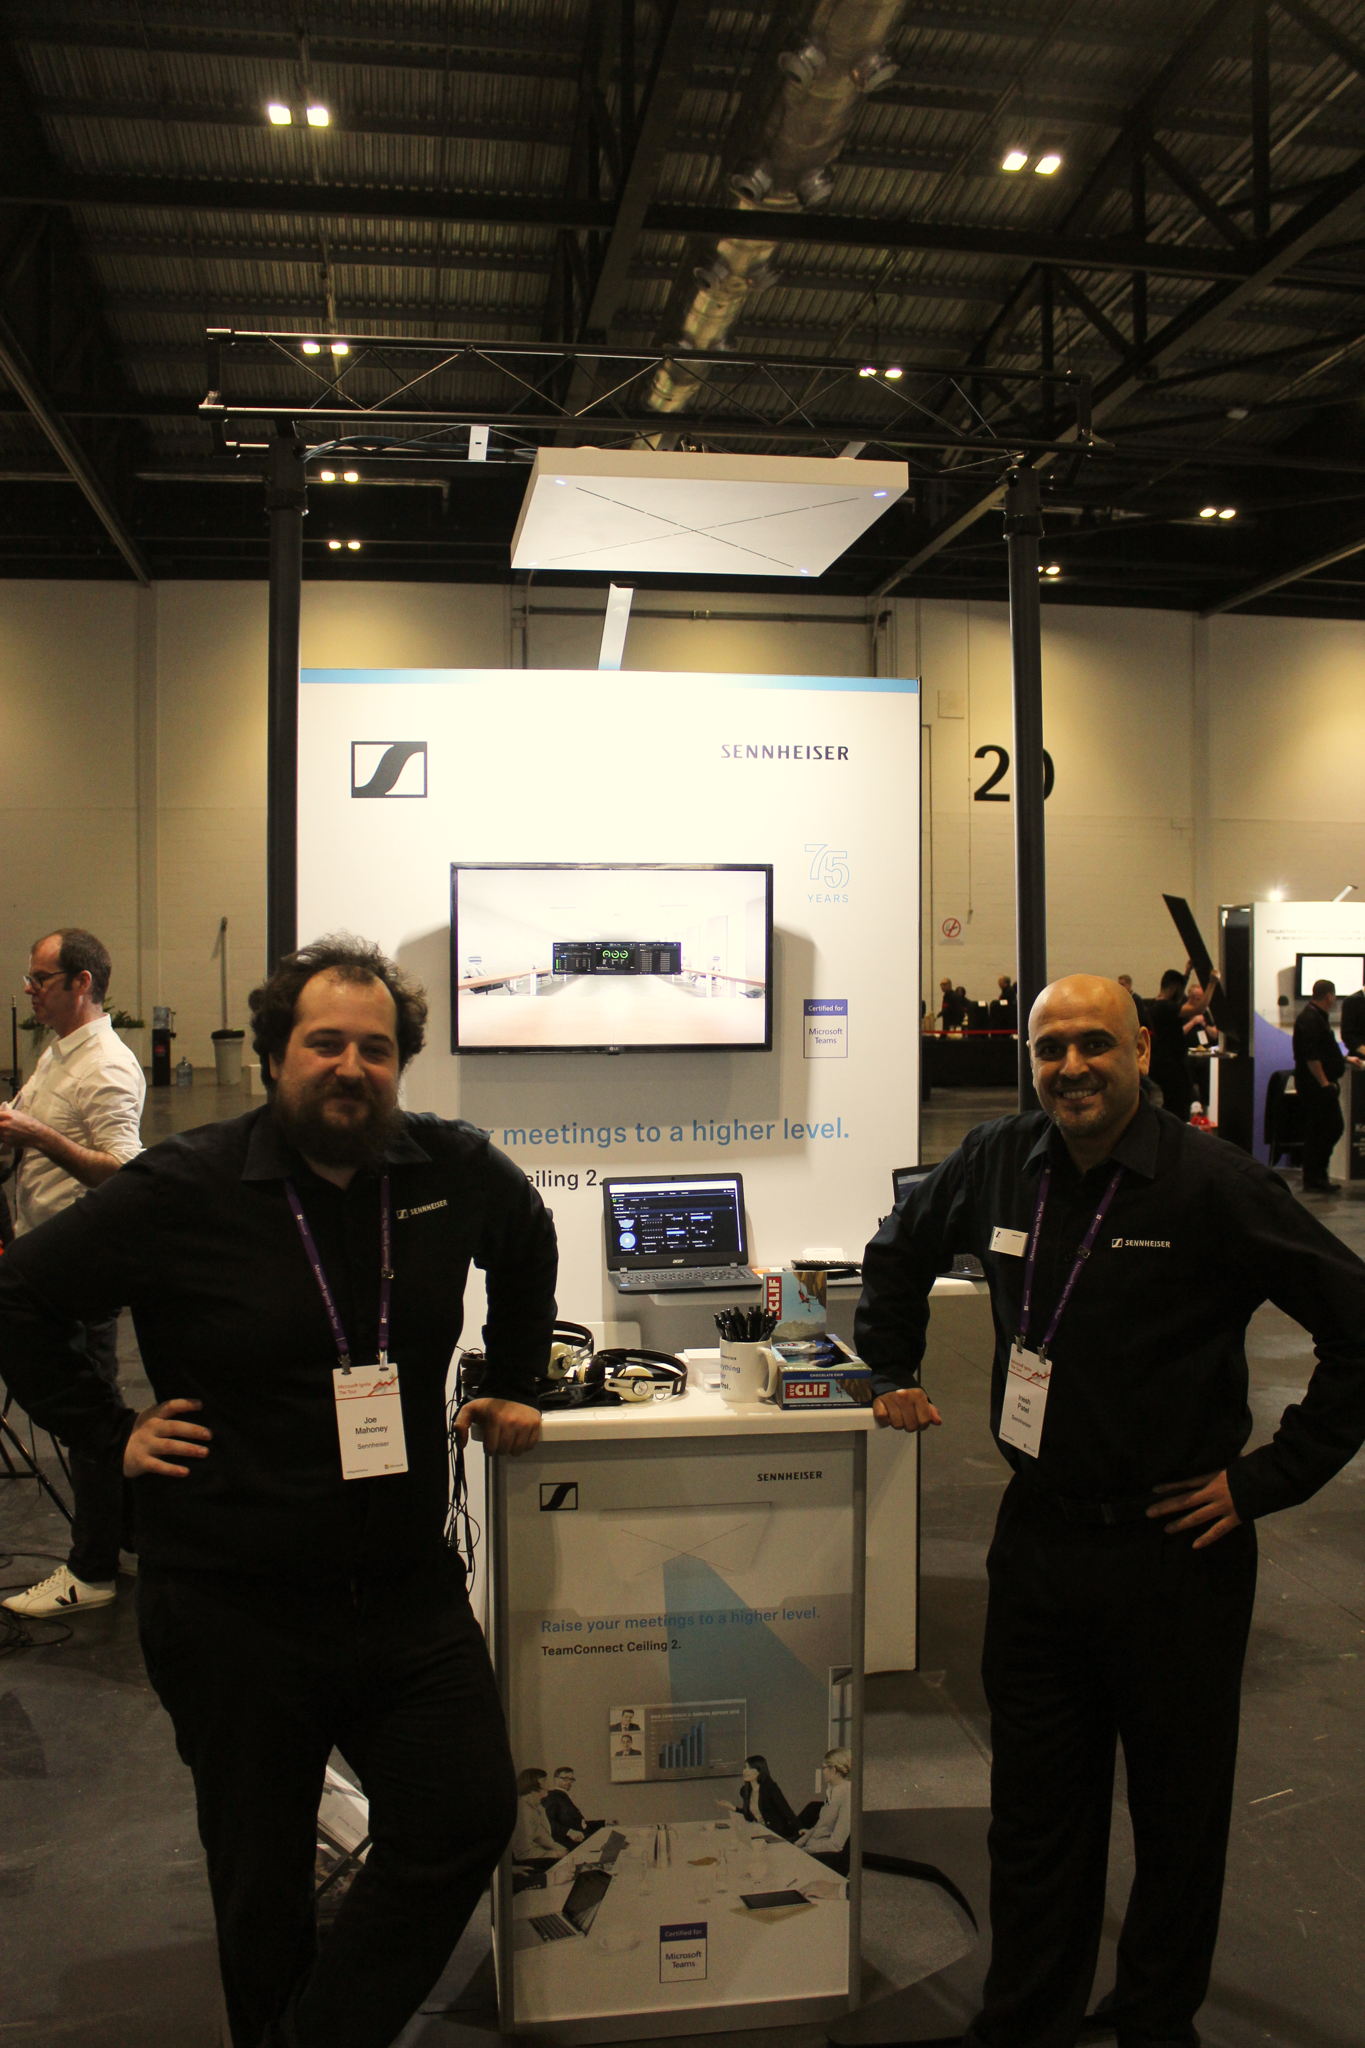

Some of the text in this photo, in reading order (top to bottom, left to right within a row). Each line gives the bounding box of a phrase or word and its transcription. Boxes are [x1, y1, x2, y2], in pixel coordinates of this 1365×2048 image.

[721, 744, 849, 761] SENNHEISER
[804, 843, 850, 889] 75
[808, 893, 849, 903] YEARS
[808, 1004, 844, 1012] Certified for
[815, 1036, 837, 1044] Teams
[503, 1117, 849, 1149] meetings to a higher level.
[525, 1170, 579, 1190] eiling
[410, 1199, 448, 1216] SENNHEISER
[1124, 1239, 1171, 1249] SENNHEISER
[768, 1279, 780, 1311] CLIF
[795, 1383, 827, 1396] CLIF
[355, 1425, 388, 1435] Mahoney
[357, 1441, 389, 1450] Sennheiser
[757, 1470, 823, 1482] SENNHEISER
[541, 1607, 820, 1633] Raise your meetings to a higher level.
[541, 1639, 682, 1656] TeamConnect Ceiling 2.
[665, 1950, 702, 1960] Microsoft
[672, 1961, 696, 1969] Teams
